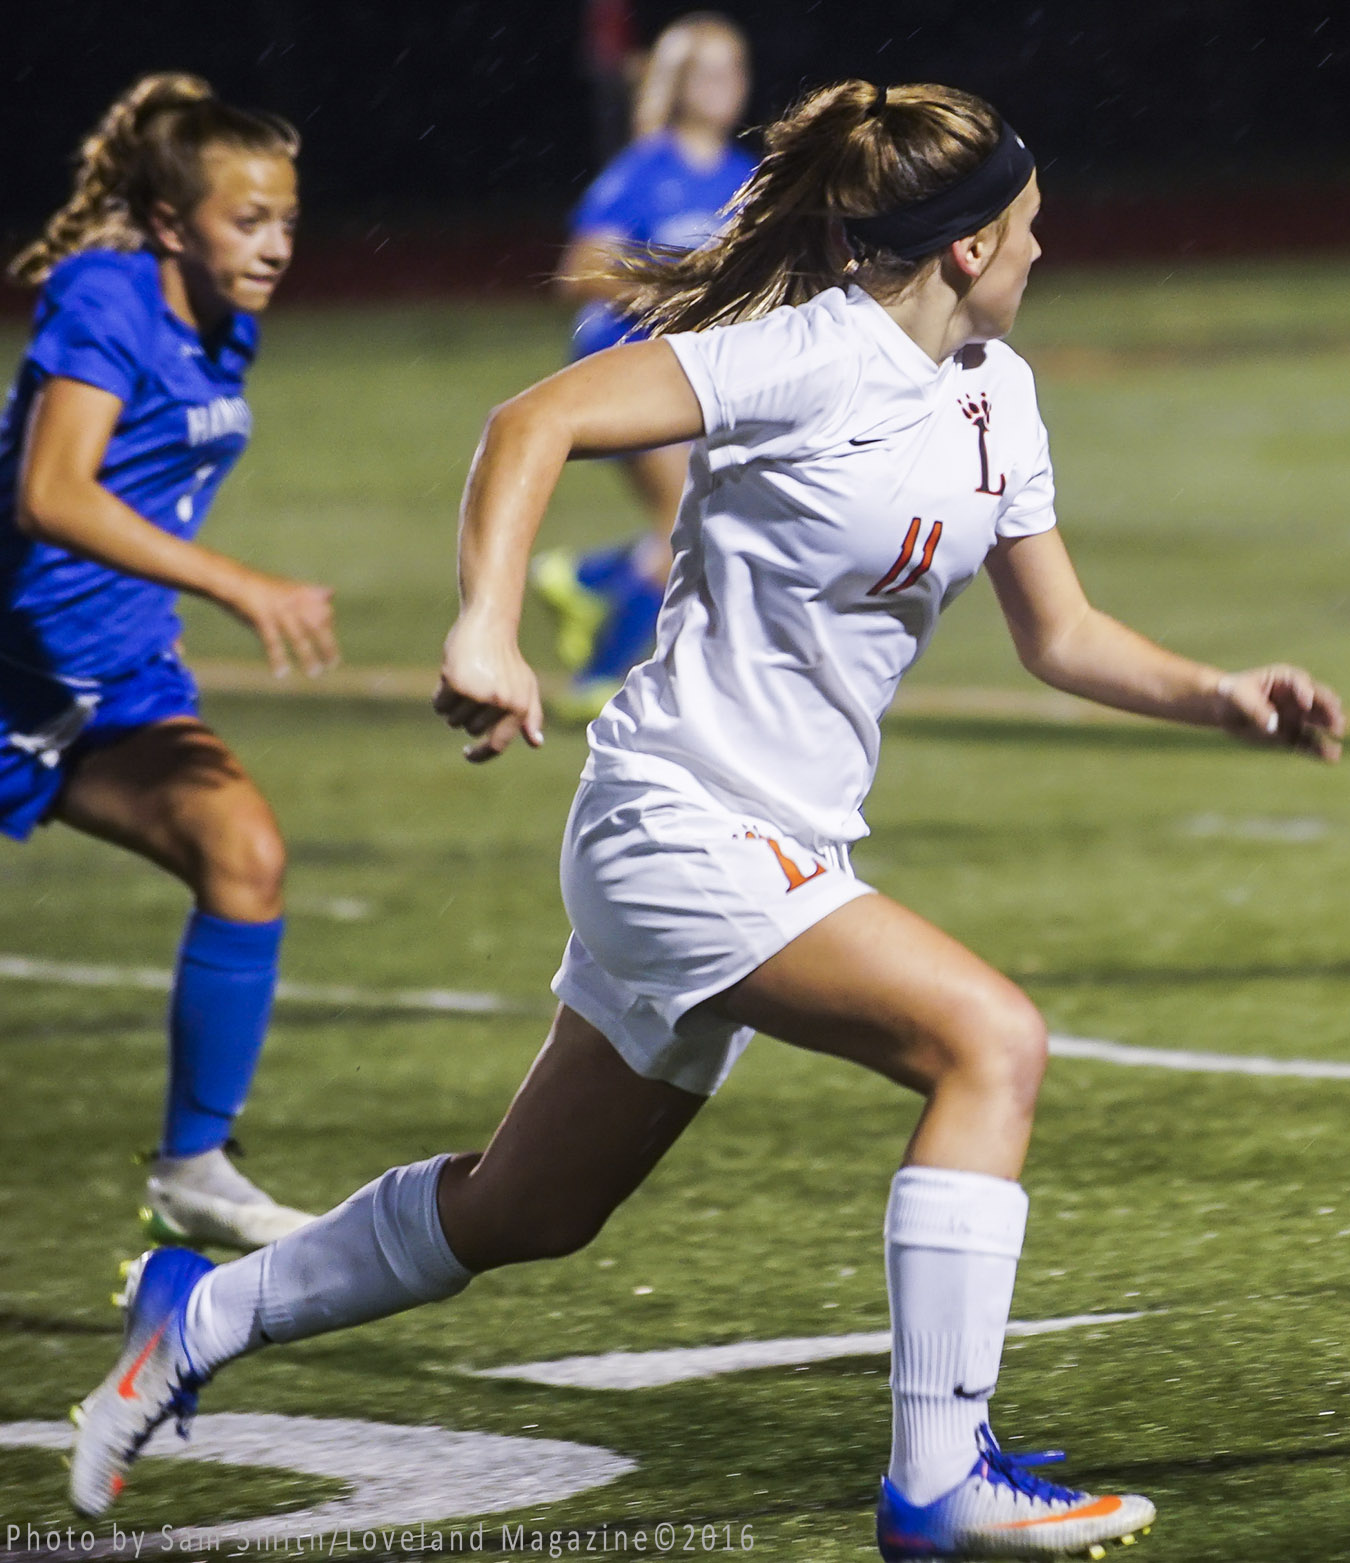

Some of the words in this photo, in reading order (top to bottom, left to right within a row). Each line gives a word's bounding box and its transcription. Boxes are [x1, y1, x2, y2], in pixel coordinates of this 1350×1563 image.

[971, 416, 1006, 496] L
[865, 516, 943, 596] 11
[759, 834, 827, 893] L
